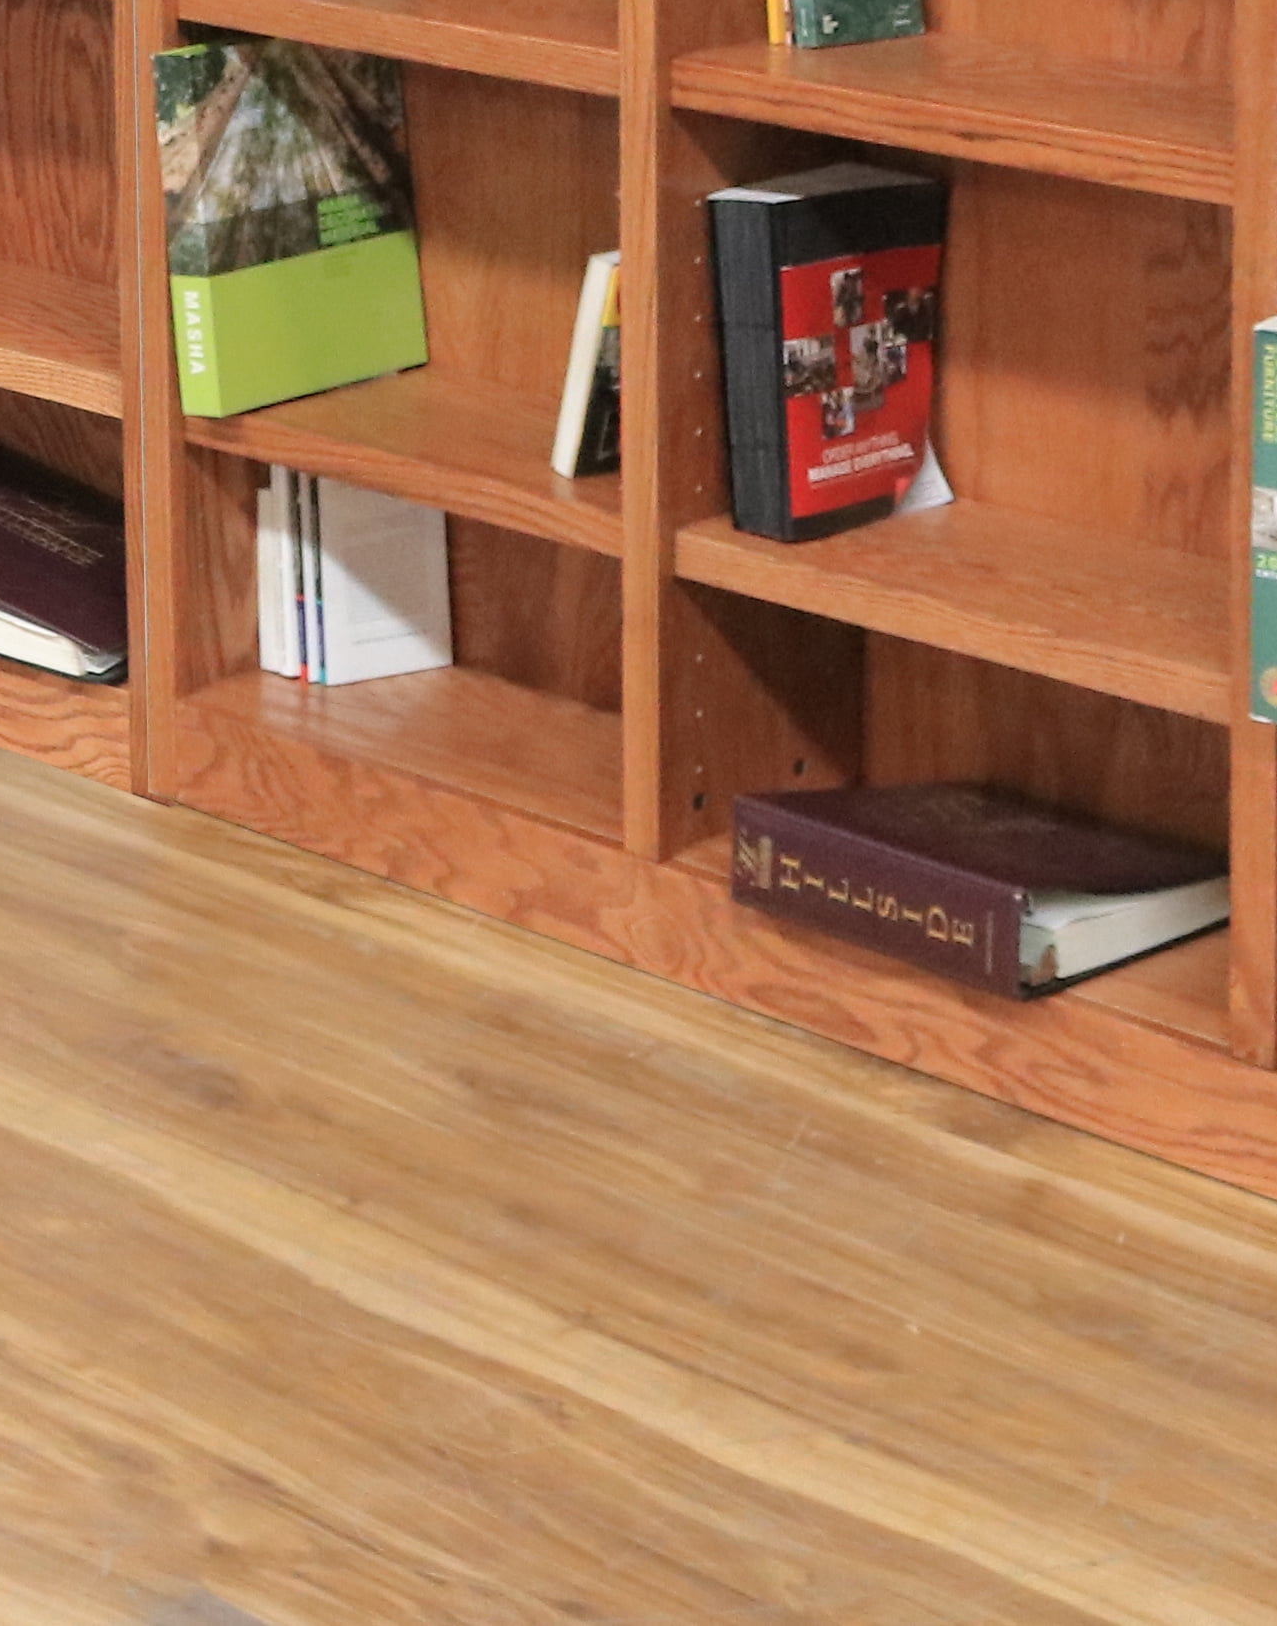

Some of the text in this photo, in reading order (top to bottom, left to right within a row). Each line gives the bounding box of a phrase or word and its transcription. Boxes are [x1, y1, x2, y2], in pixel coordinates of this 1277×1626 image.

[183, 289, 206, 375] MASHA
[1262, 344, 1276, 444] FURNITURE
[779, 852, 974, 948] HILLSIDE
